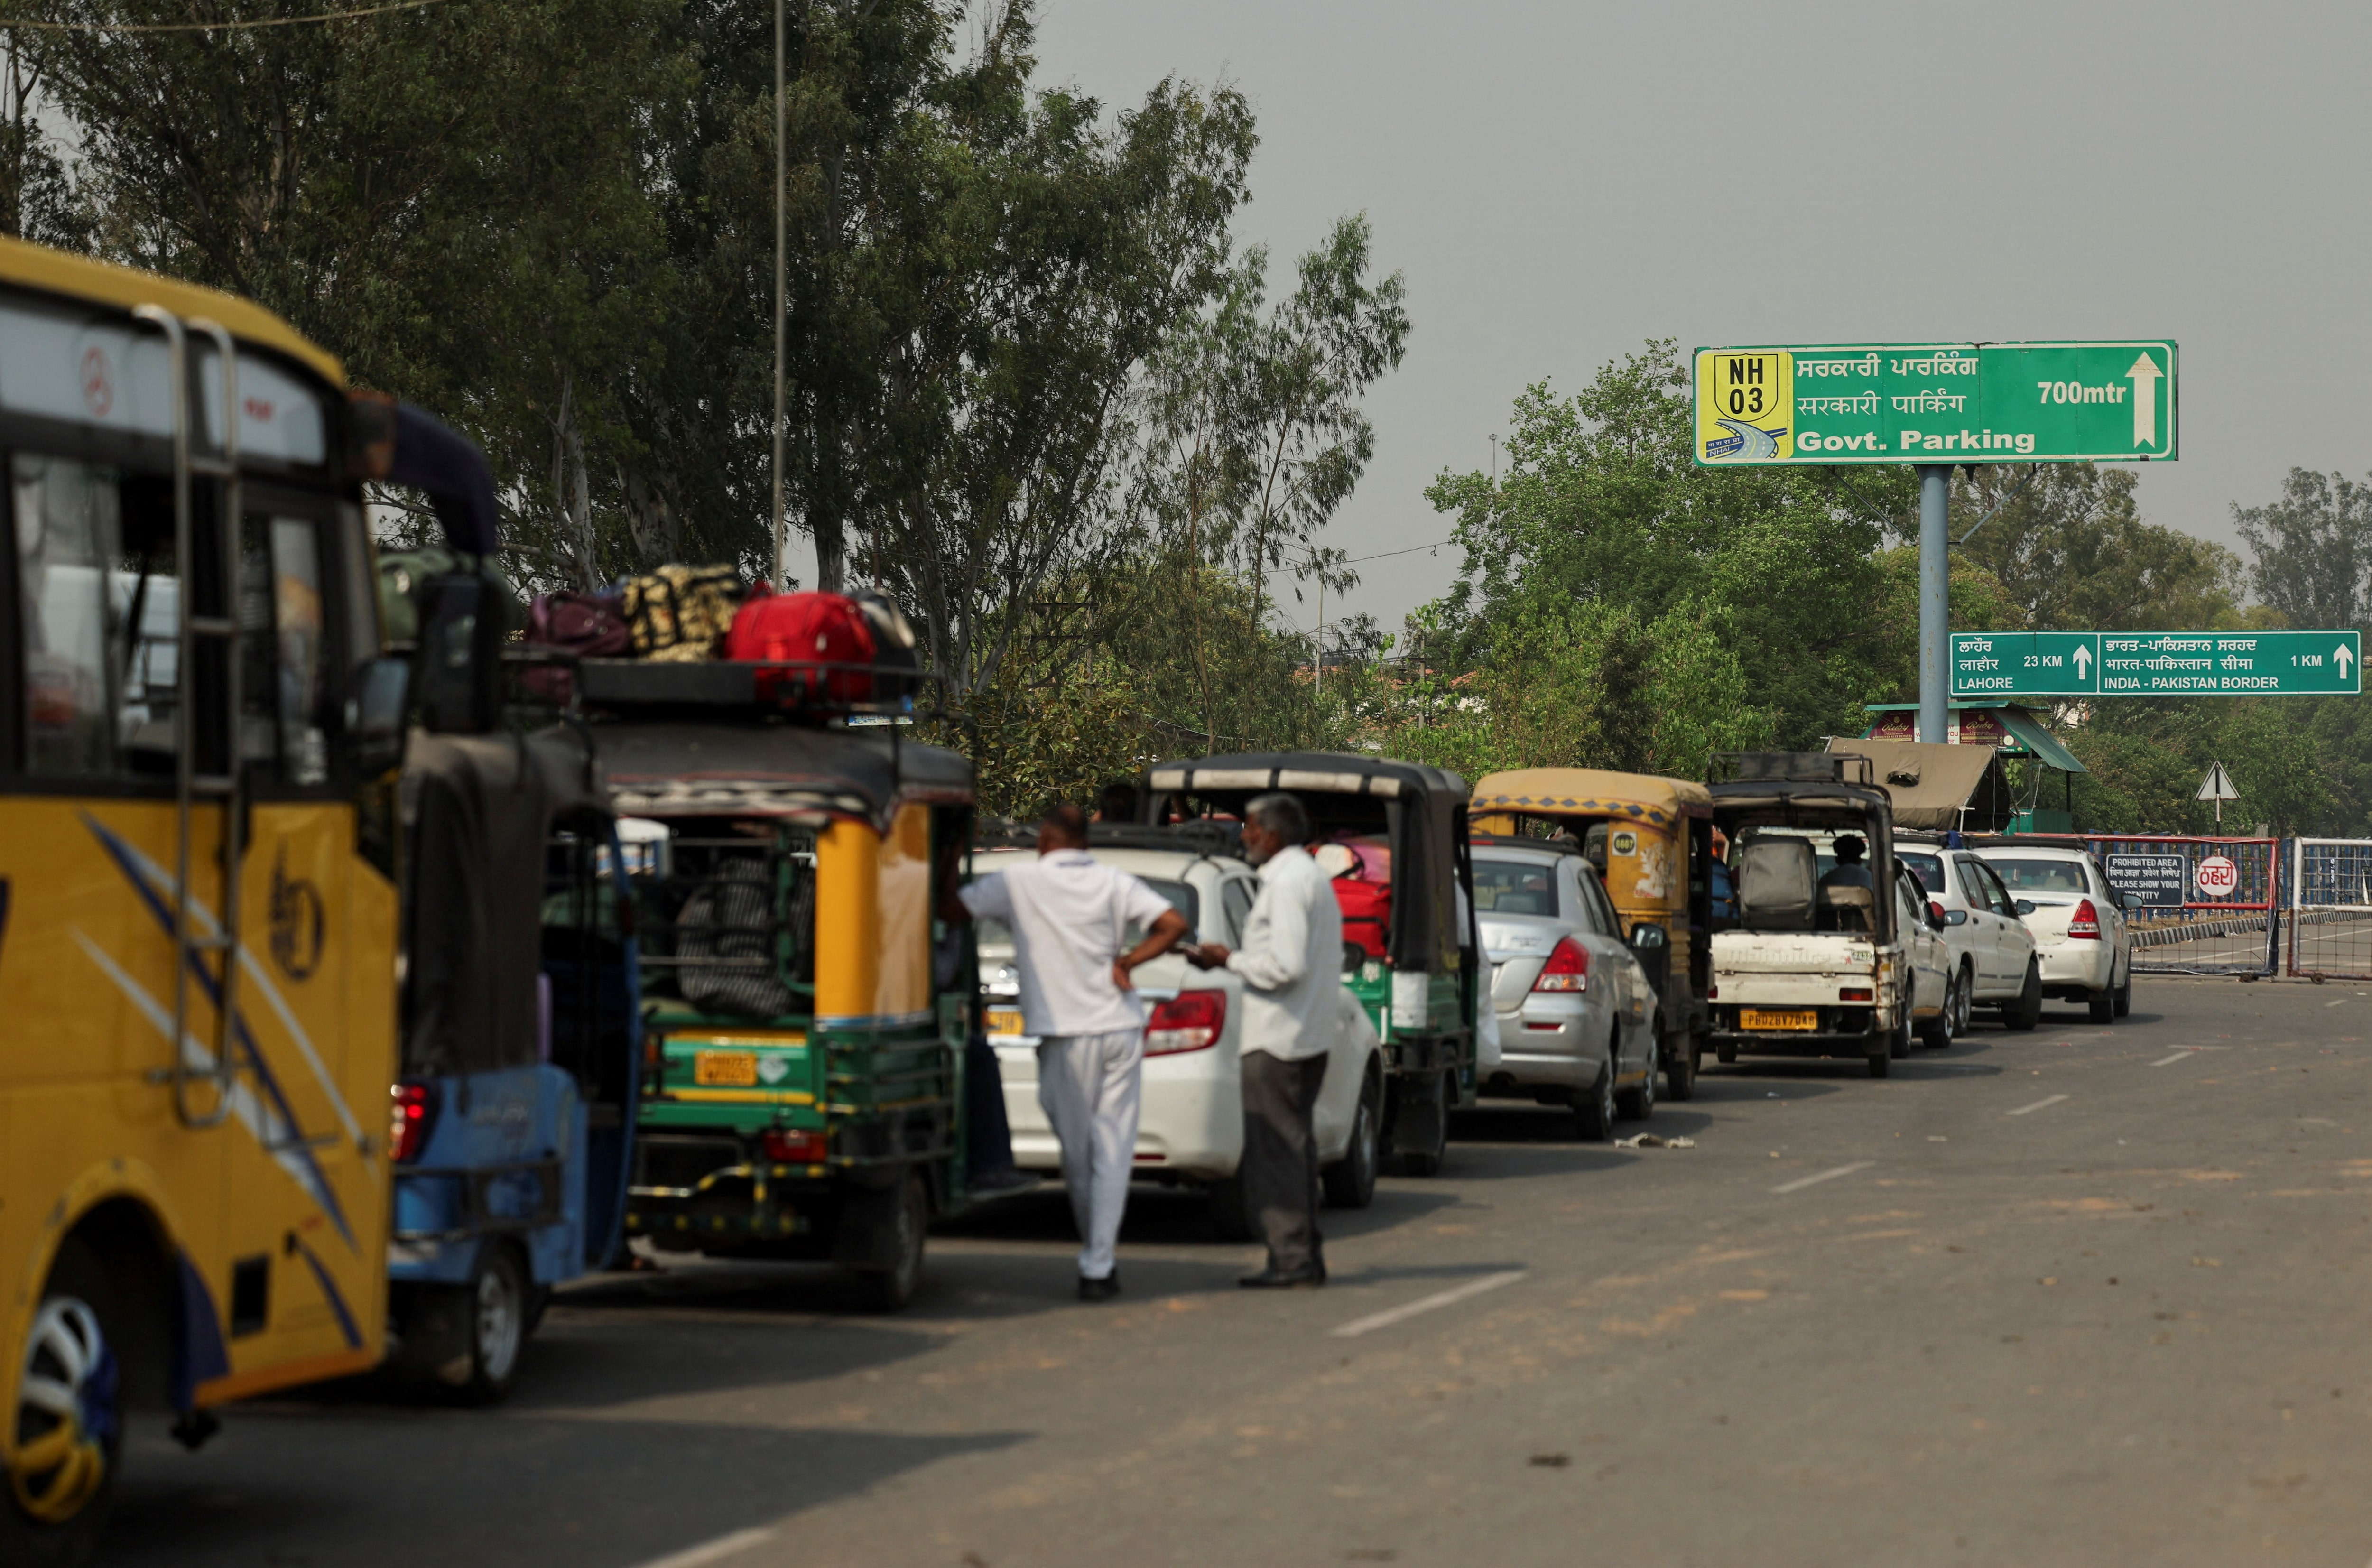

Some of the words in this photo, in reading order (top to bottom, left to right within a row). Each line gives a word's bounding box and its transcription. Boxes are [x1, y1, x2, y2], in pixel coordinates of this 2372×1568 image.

[1730, 358, 1763, 384] NH
[1797, 353, 1881, 377] ਸਰਕਾਰੀ
[1890, 351, 1979, 376] ਪਾਰਕਿੰਗ
[1730, 387, 1763, 414] 03
[2038, 382, 2126, 404] 700mtr
[1797, 390, 1882, 416] सरकारी
[1797, 431, 1887, 451] Govt.
[1901, 429, 2035, 453] Parking
[1710, 446, 1730, 456] NHAI
[1958, 655, 1999, 672] लाहौर
[2024, 655, 2038, 667] 23
[2043, 655, 2062, 667] KM
[2219, 655, 2253, 670] सीमा
[2291, 655, 2297, 666] 1
[2302, 655, 2322, 666] KM
[1959, 678, 2013, 689] LAHORE
[2105, 677, 2141, 689] INDIA
[2152, 677, 2217, 689] PAKISTAN
[2221, 677, 2279, 688] BORDER
[1882, 723, 1909, 731] Ruby
[1966, 721, 1994, 729] Ruby
[2113, 858, 2156, 866] PROHIBITED
[2200, 862, 2234, 885] ठहरो
